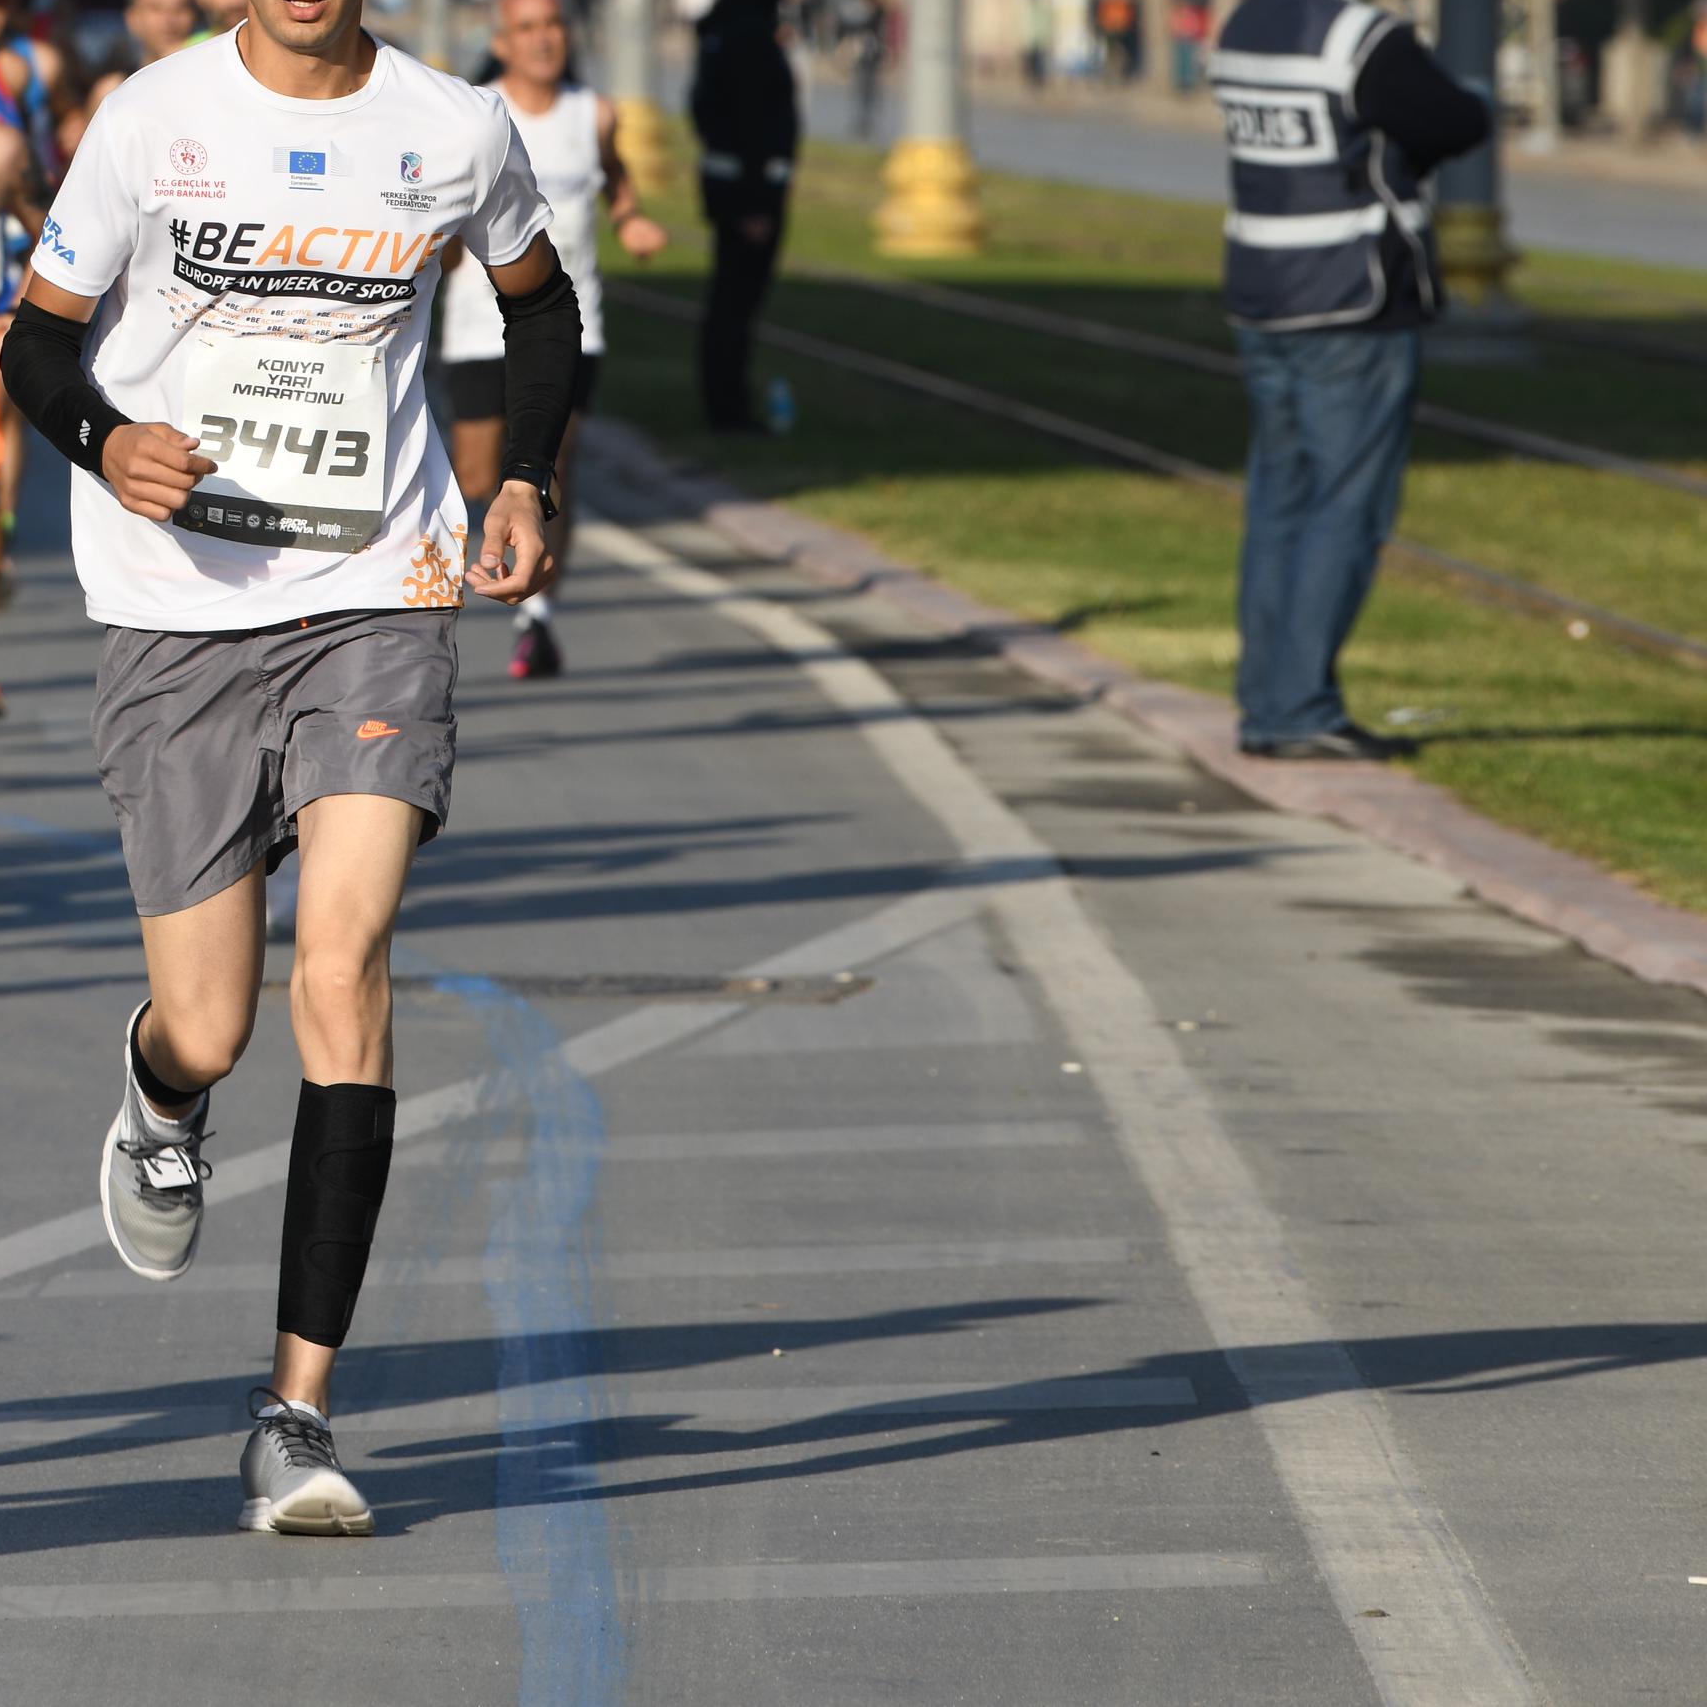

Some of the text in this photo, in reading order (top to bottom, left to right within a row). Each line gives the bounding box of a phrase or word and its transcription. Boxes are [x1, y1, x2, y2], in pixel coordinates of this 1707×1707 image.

[154, 179, 169, 187] T.C.
[171, 179, 210, 189] GENÇLİK
[154, 189, 226, 198] SPOR BAKANLIĞI
[380, 191, 407, 200] HERKES
[420, 194, 437, 203] SPOR
[385, 199, 432, 209] FEDERASYONU
[169, 218, 444, 274] #BEACTIVE
[178, 261, 414, 300] EUROPEAN WEEK OF SPOR
[257, 358, 325, 375] KONYA
[268, 373, 312, 389] YARI
[232, 383, 344, 405] MARATONU
[198, 414, 371, 478] 3443
[364, 720, 388, 732] NIKE
